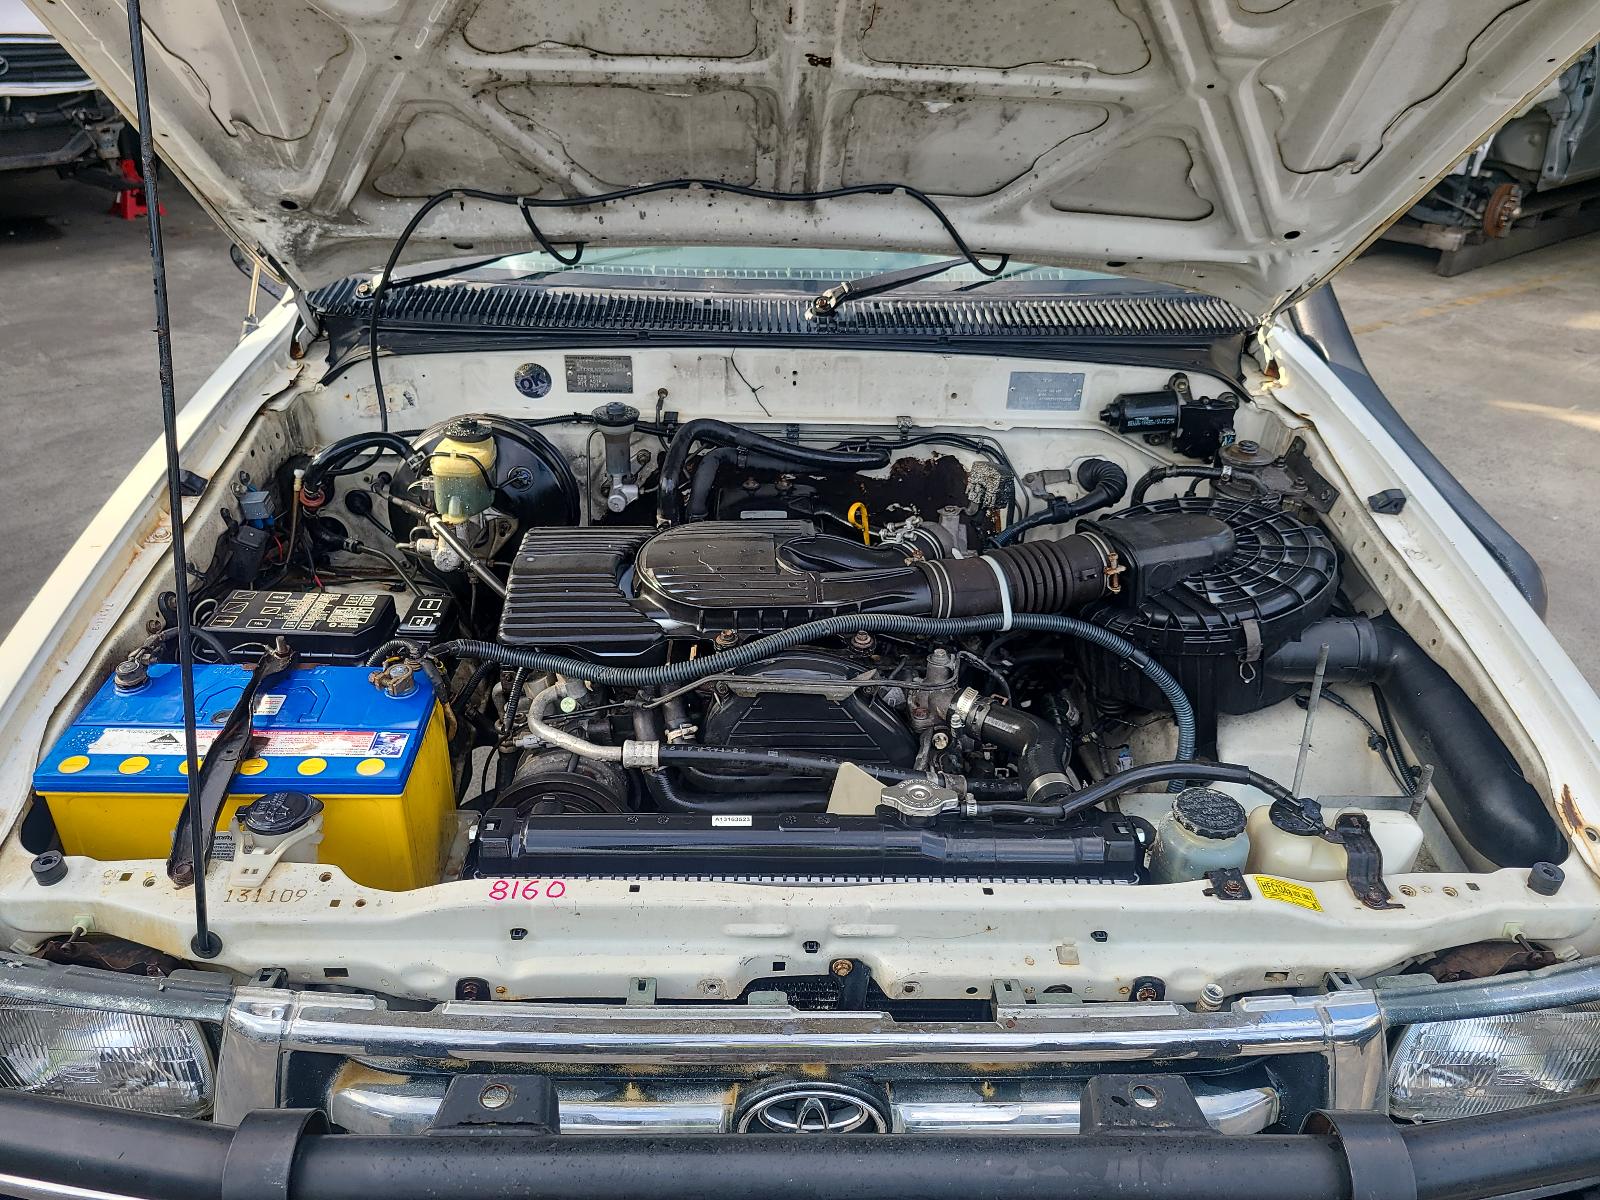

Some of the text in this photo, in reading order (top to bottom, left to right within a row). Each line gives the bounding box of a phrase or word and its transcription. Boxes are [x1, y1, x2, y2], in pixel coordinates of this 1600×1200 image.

[519, 372, 547, 391] OK
[223, 888, 308, 903] 131109
[488, 880, 566, 900] 8160
